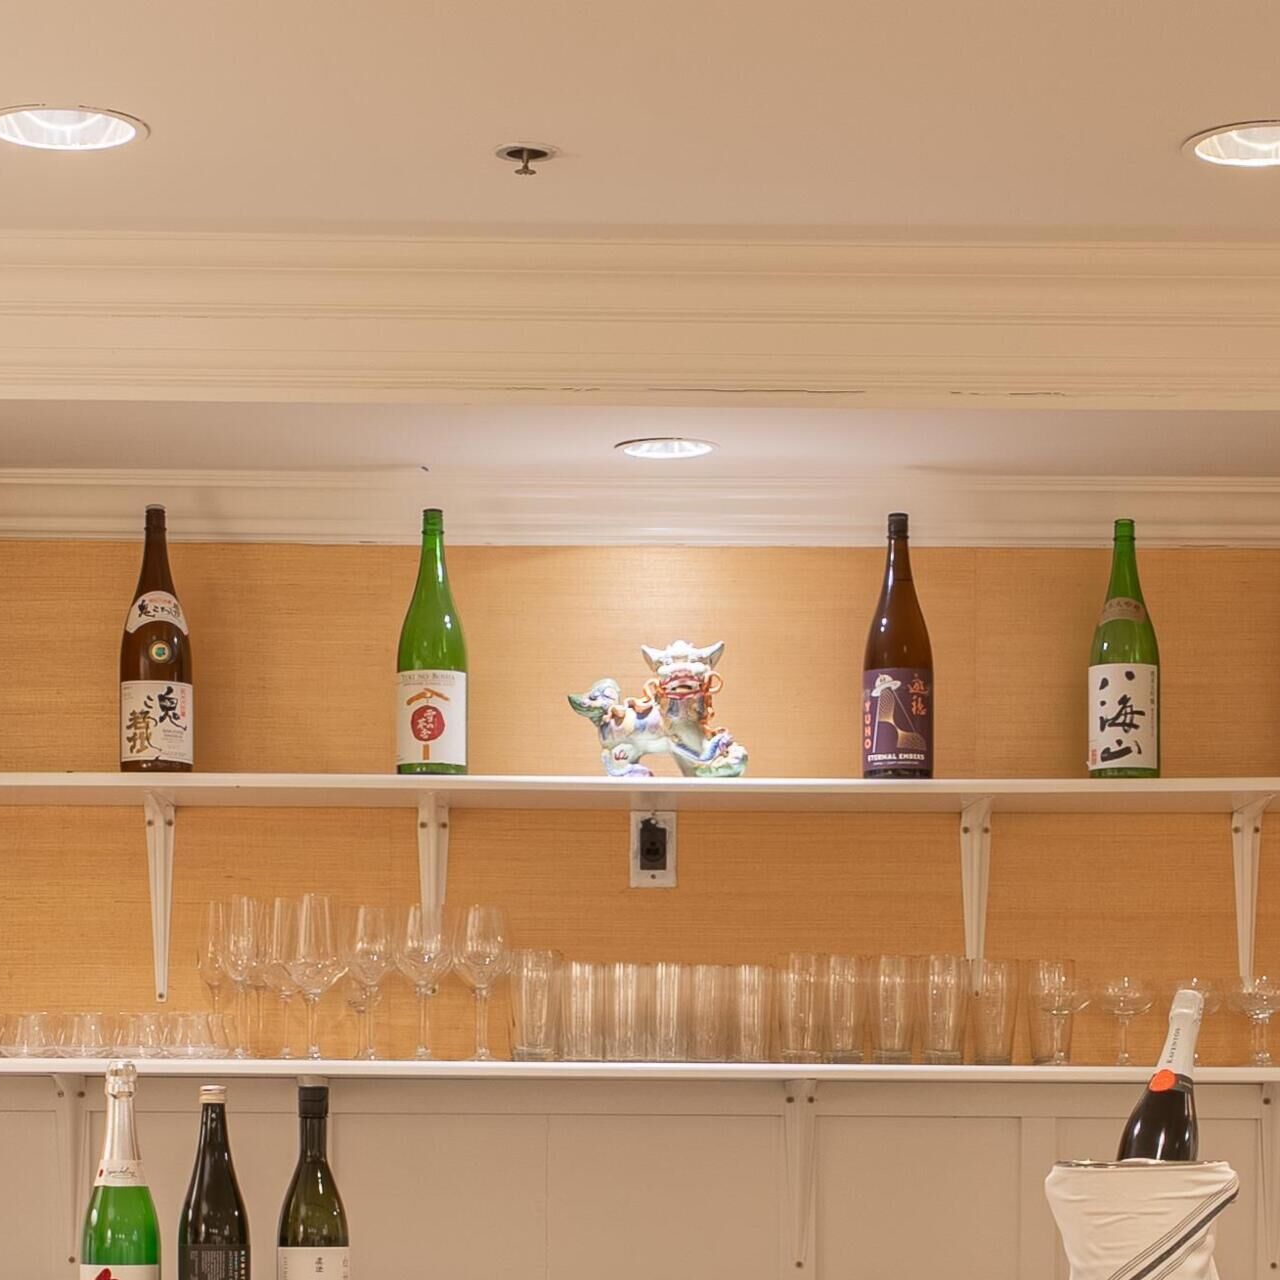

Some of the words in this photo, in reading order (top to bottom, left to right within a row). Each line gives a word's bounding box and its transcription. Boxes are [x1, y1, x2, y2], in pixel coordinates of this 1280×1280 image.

[864, 701, 872, 749] YUHO
[1099, 671, 1145, 761] 八海山
